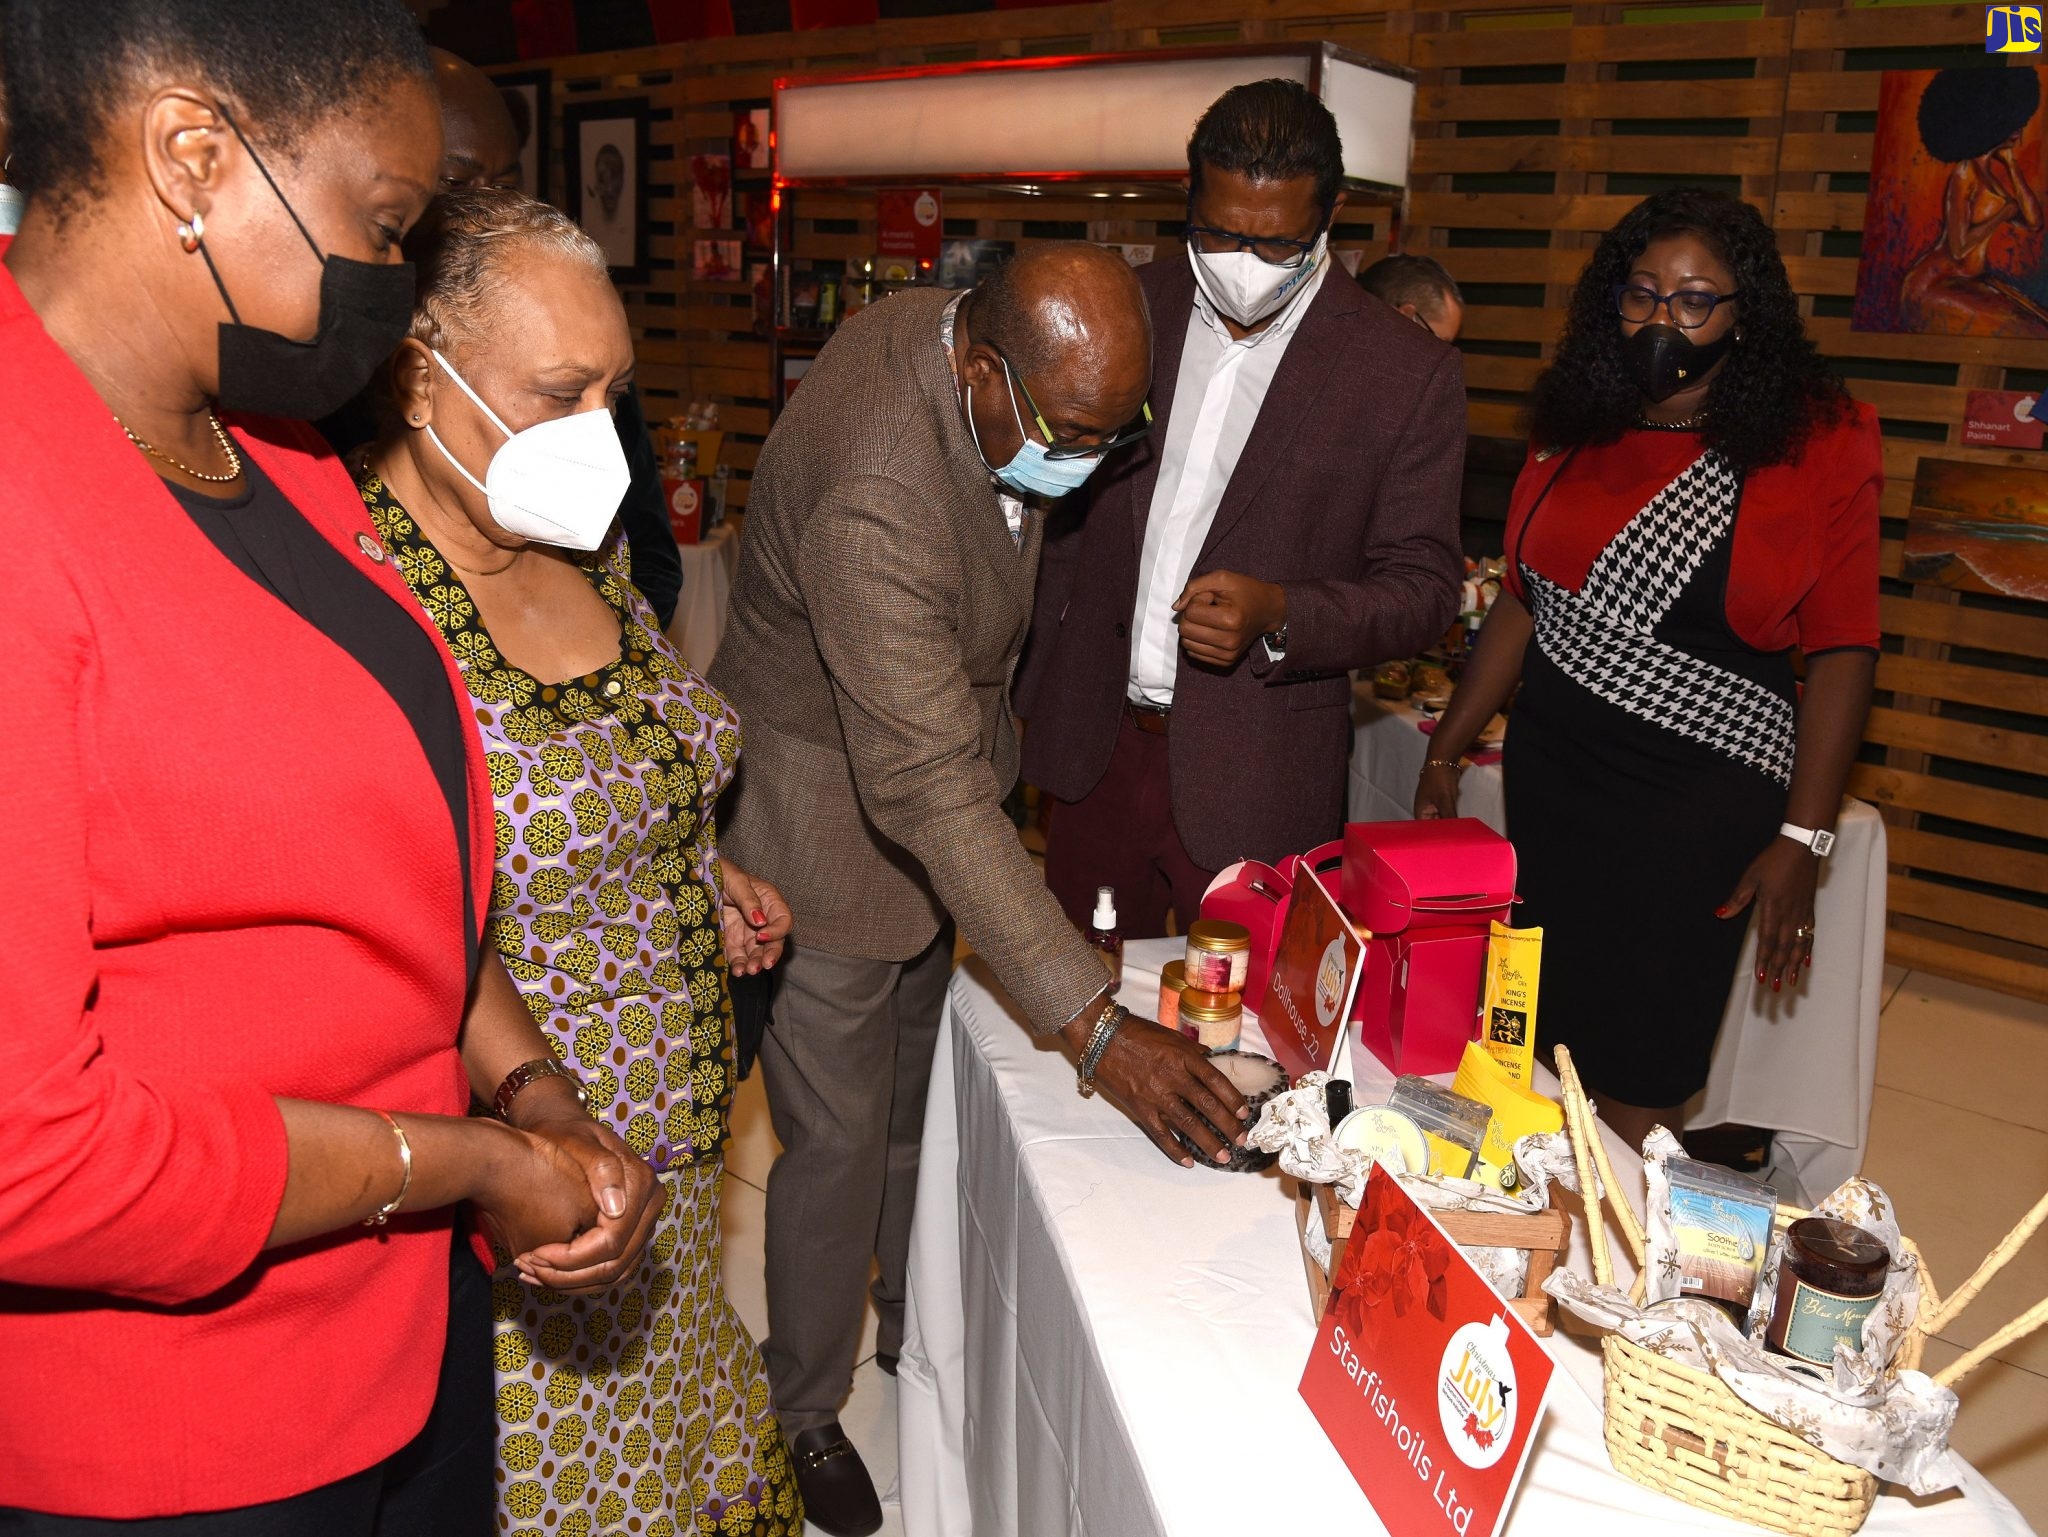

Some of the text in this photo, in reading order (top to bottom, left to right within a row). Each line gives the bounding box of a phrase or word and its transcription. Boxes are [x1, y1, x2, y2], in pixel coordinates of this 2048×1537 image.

[1966, 431, 1996, 441] Paints
[1505, 989, 1527, 998] KING'S
[1500, 997, 1526, 1008] INCENSE
[1801, 1296, 1832, 1318] Blue
[1466, 1341, 1498, 1381] Christmas
[1474, 1365, 1482, 1376] in
[1449, 1349, 1503, 1429] July
[1329, 1325, 1474, 1537] Starfishoils Ltd
